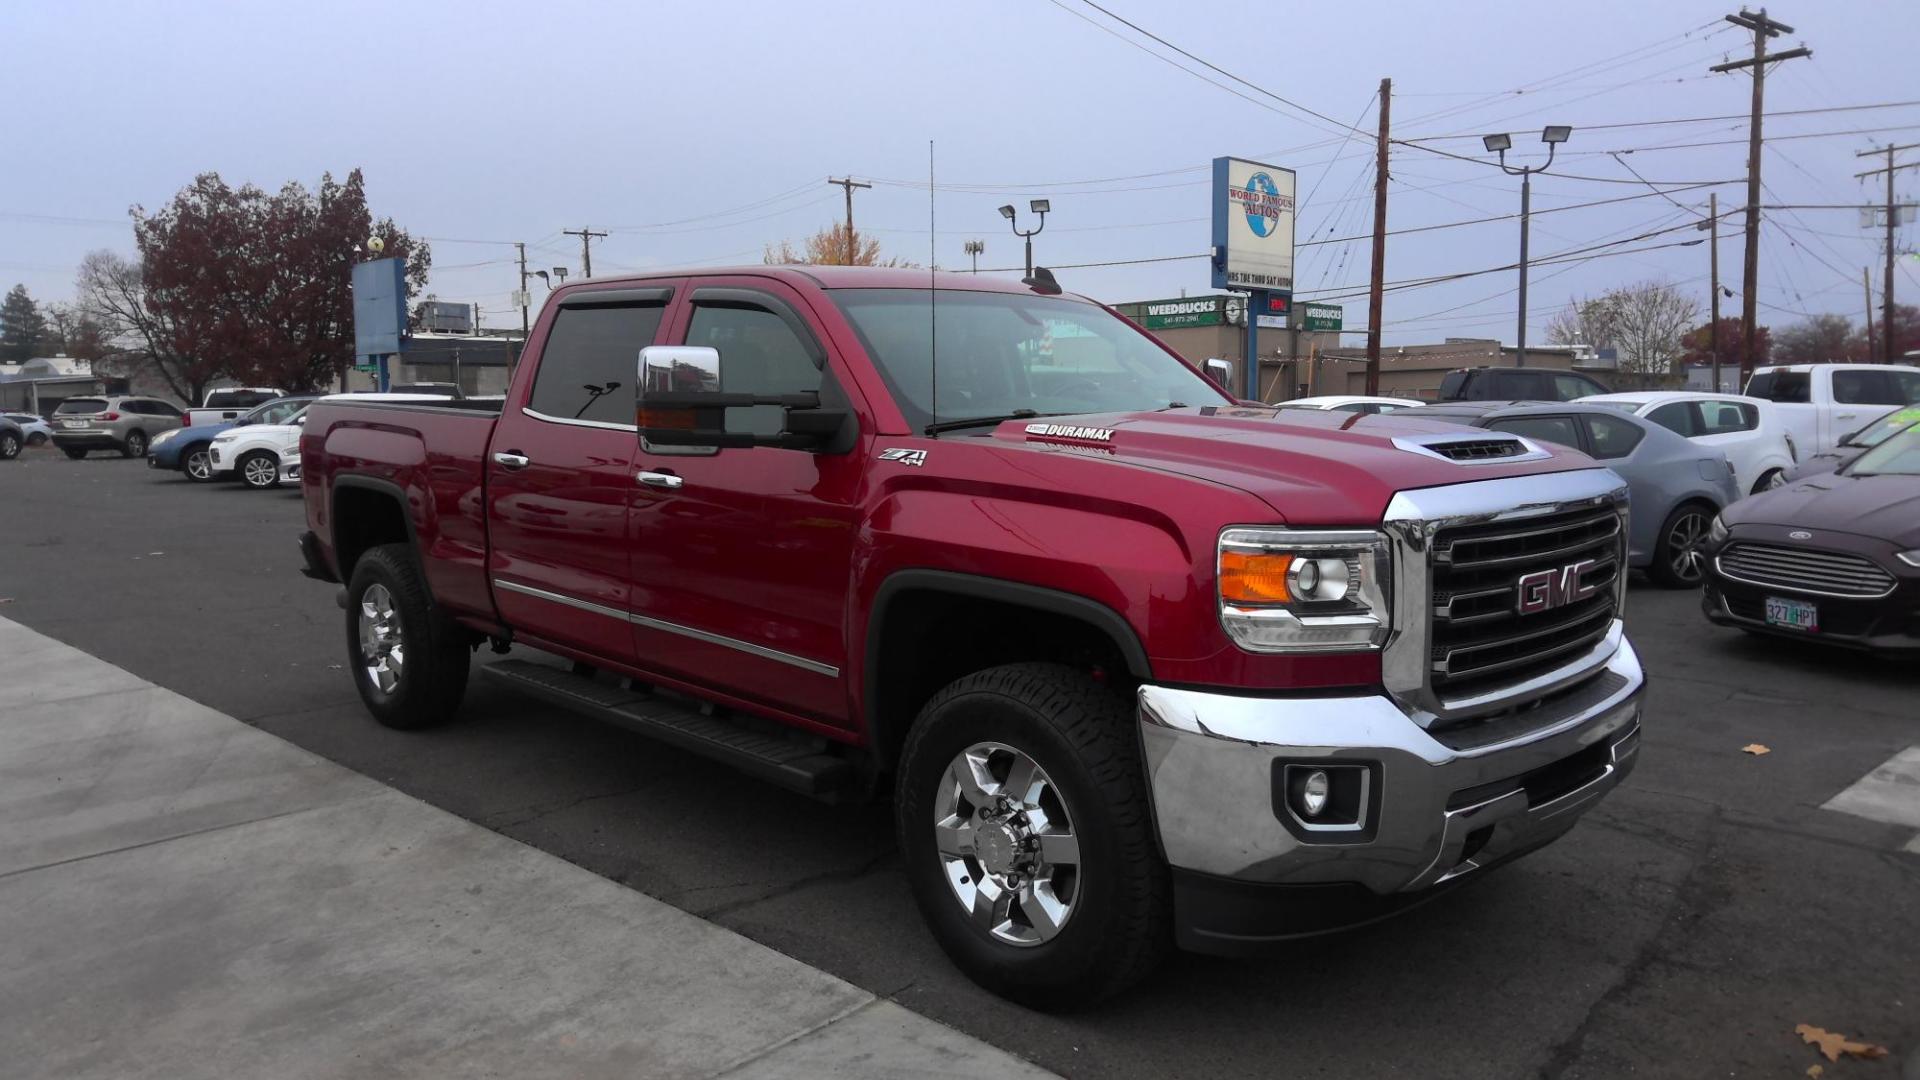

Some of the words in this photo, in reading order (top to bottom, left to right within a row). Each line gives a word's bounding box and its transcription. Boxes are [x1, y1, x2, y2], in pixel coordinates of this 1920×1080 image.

[1229, 189, 1260, 203] WORLD
[1262, 195, 1293, 209] FAMOUS
[1266, 275, 1276, 286] SAT
[1148, 300, 1216, 316] WEEDBUCKS
[1306, 308, 1342, 320] WEEDBUCKS
[1047, 424, 1116, 441] DURAMAX
[1519, 559, 1595, 616] GMC
[1767, 604, 1788, 621] 327
[1795, 607, 1816, 626] HPT
